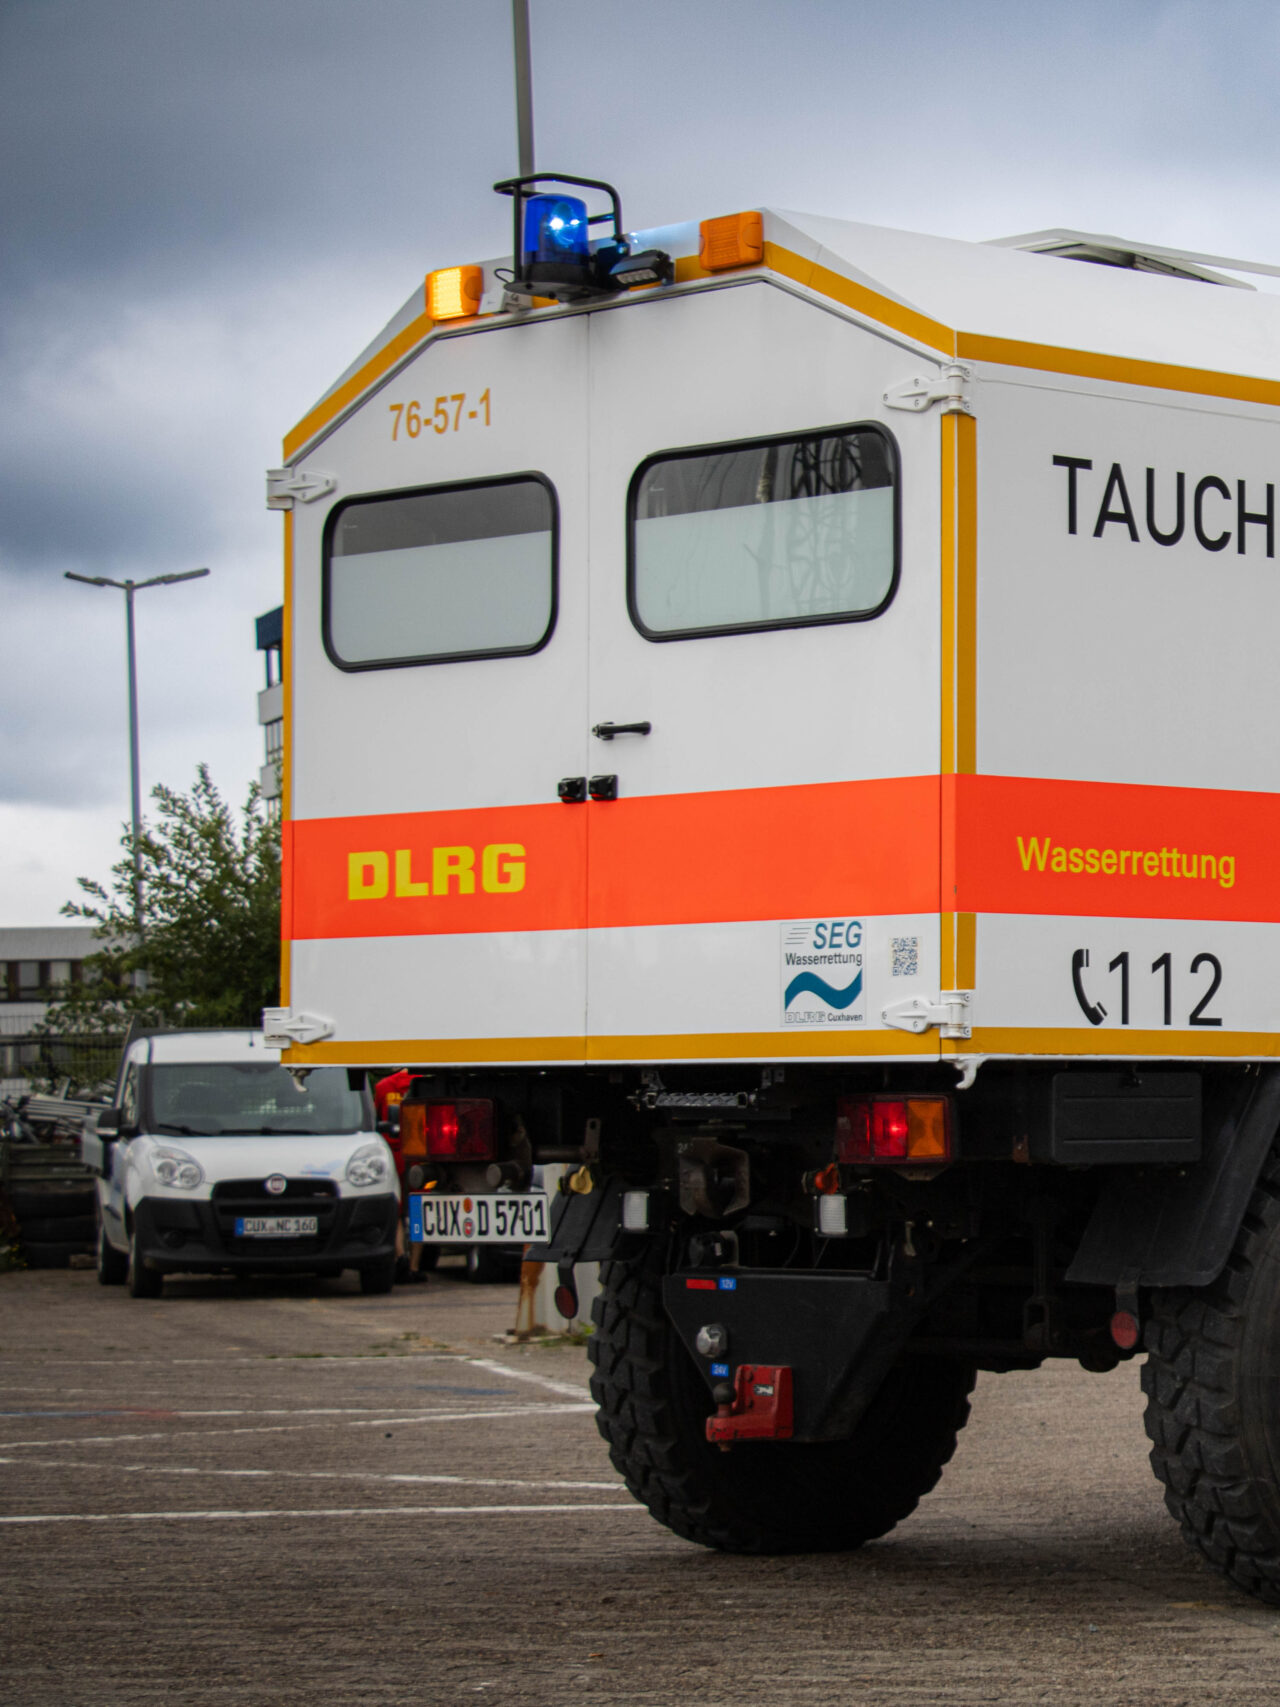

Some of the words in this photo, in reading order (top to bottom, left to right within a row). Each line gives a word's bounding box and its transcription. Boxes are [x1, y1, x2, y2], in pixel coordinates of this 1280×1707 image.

[389, 387, 493, 441] 76-57-1
[347, 842, 527, 901] DLRG
[1016, 835, 1237, 889] Wasserrettung
[813, 920, 863, 949] SEG
[785, 951, 863, 967] Wasserrettung
[1108, 950, 1223, 1027] 112
[784, 1011, 826, 1024] DLRG
[827, 1011, 863, 1022] Cuxhaven
[244, 1219, 269, 1232] CUX
[423, 1200, 462, 1236] CUX
[477, 1200, 490, 1236] D
[495, 1199, 547, 1236] 5701
